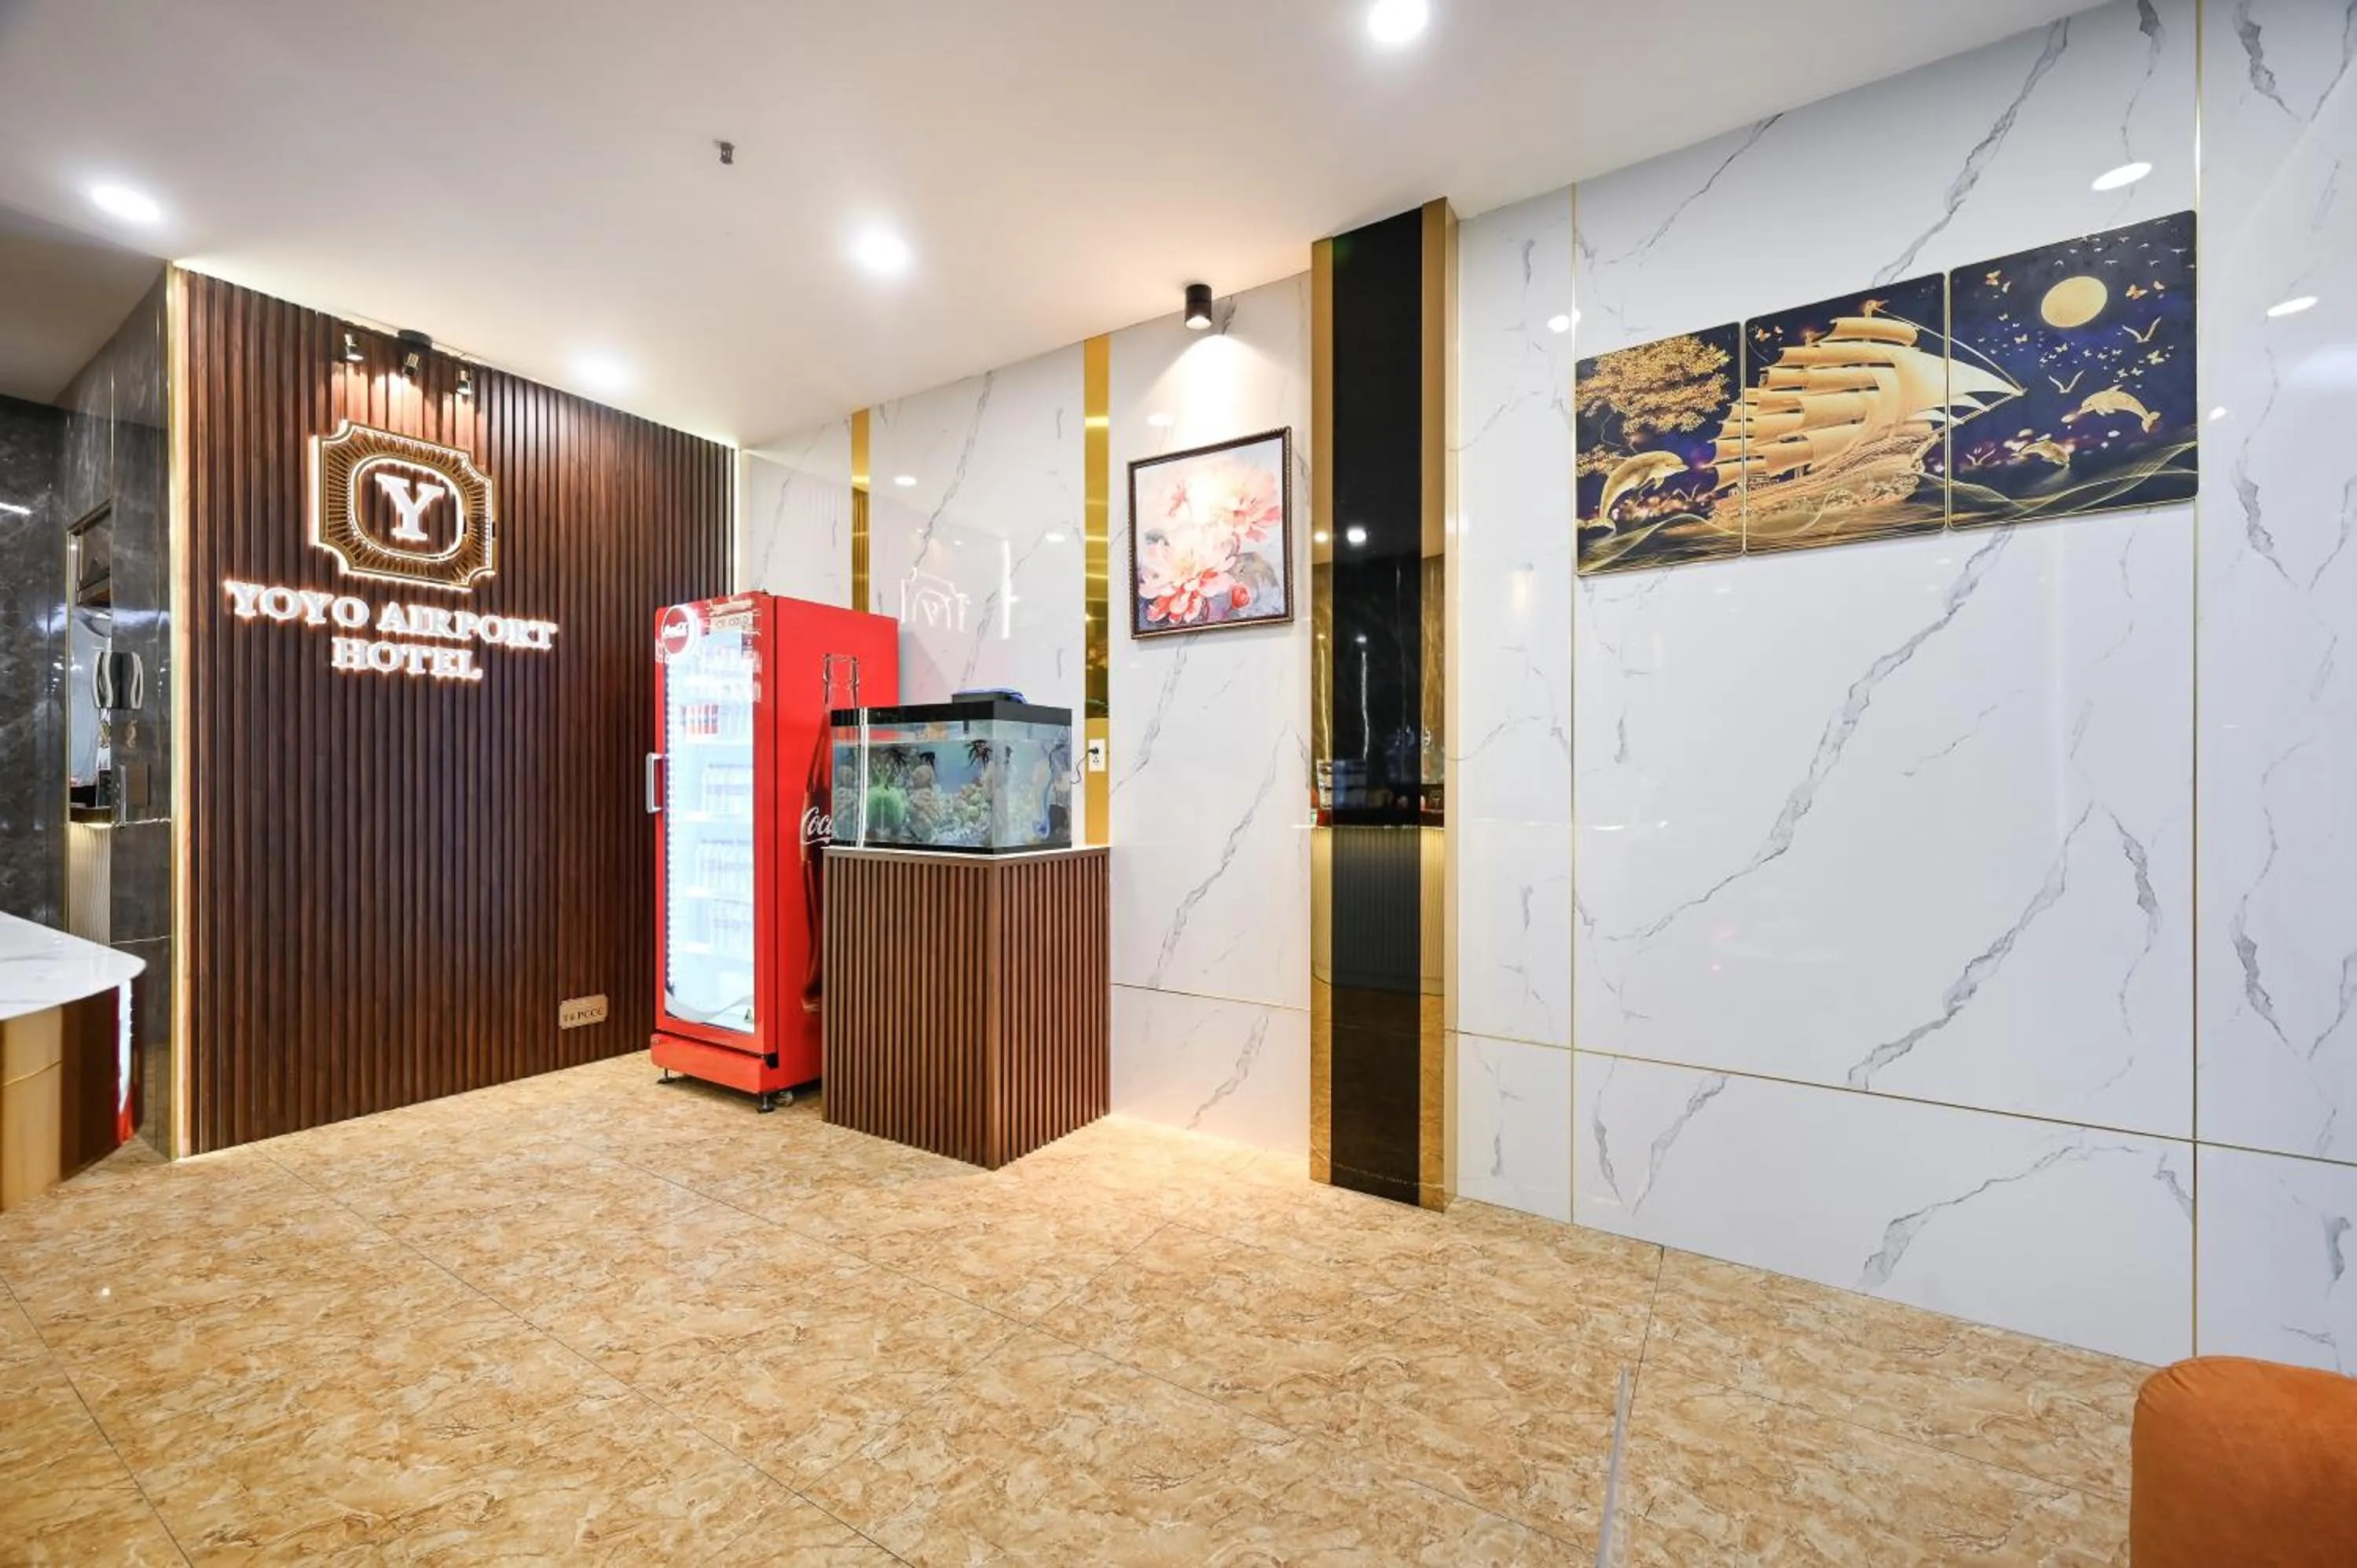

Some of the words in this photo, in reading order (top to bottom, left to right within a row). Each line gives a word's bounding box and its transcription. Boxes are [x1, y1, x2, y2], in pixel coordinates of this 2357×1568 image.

[375, 473, 445, 541] Y
[225, 581, 370, 628] YOYO
[376, 602, 559, 649] AIRPORT
[331, 636, 483, 680] HOTEL
